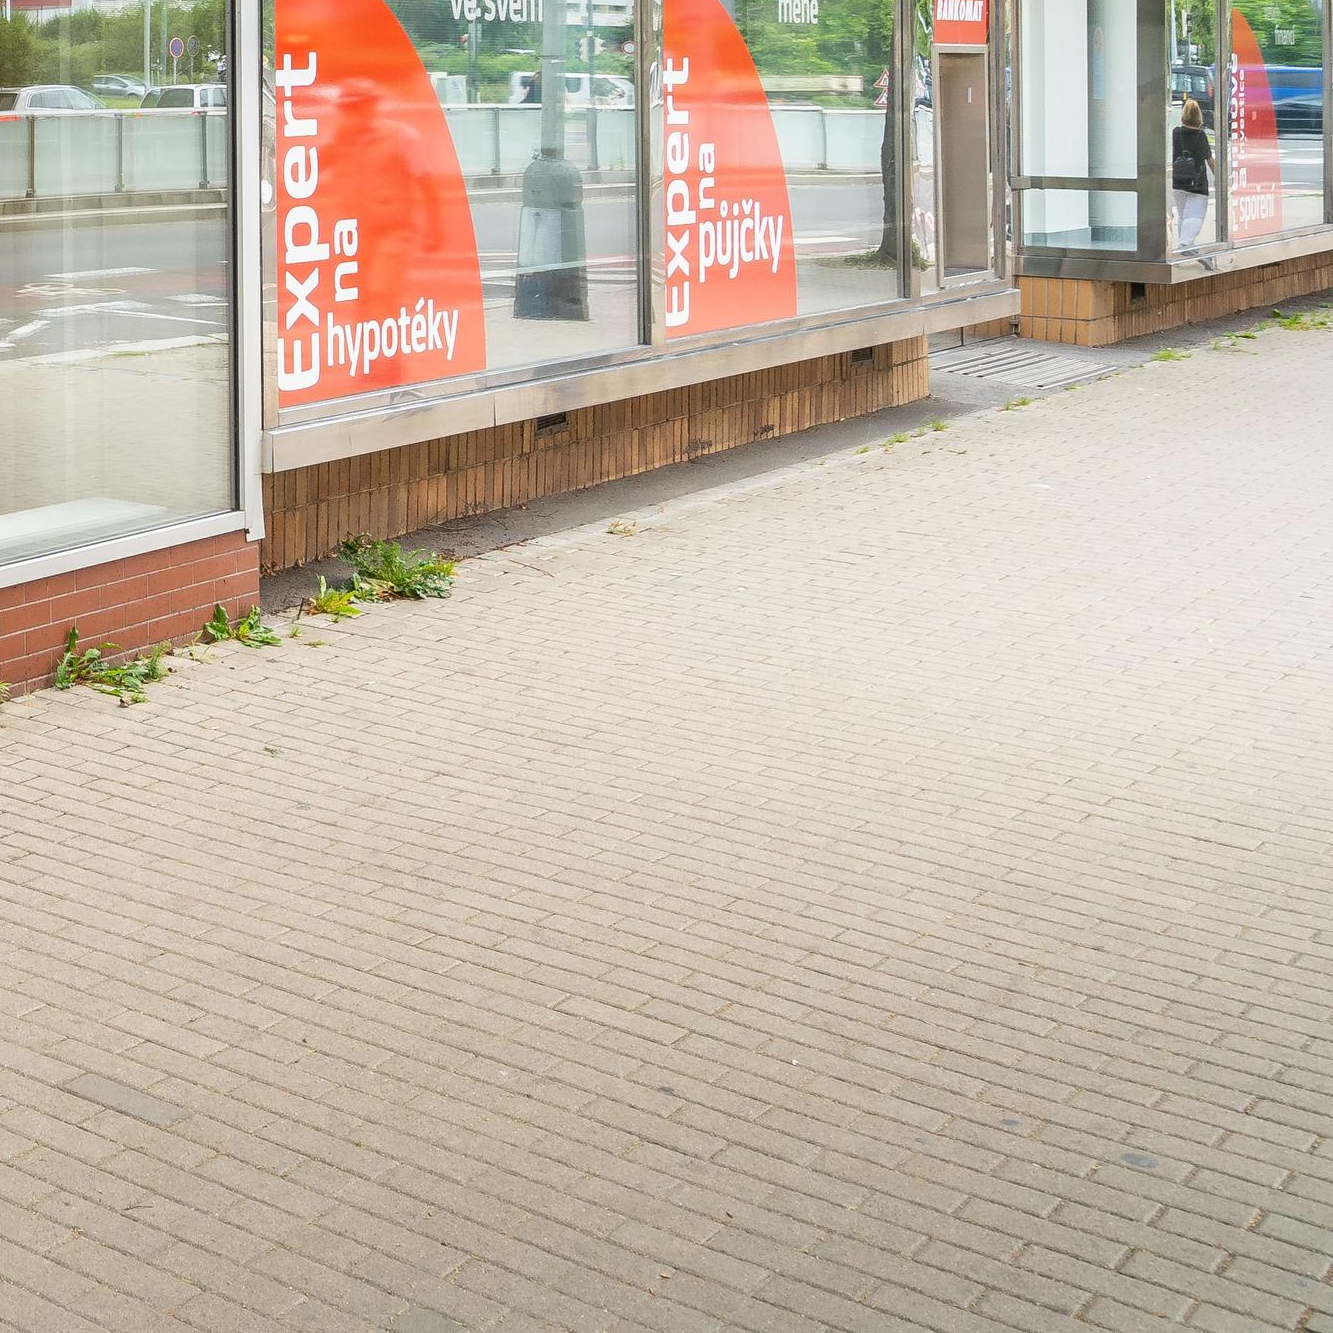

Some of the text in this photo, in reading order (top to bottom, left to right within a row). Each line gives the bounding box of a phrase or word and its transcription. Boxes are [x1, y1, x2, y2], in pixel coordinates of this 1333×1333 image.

[663, 57, 695, 328] Expert
[698, 142, 716, 209] na
[276, 51, 330, 391] Expert
[334, 218, 359, 303] na
[698, 198, 783, 283] půjčky
[327, 297, 459, 377] hypotéky
